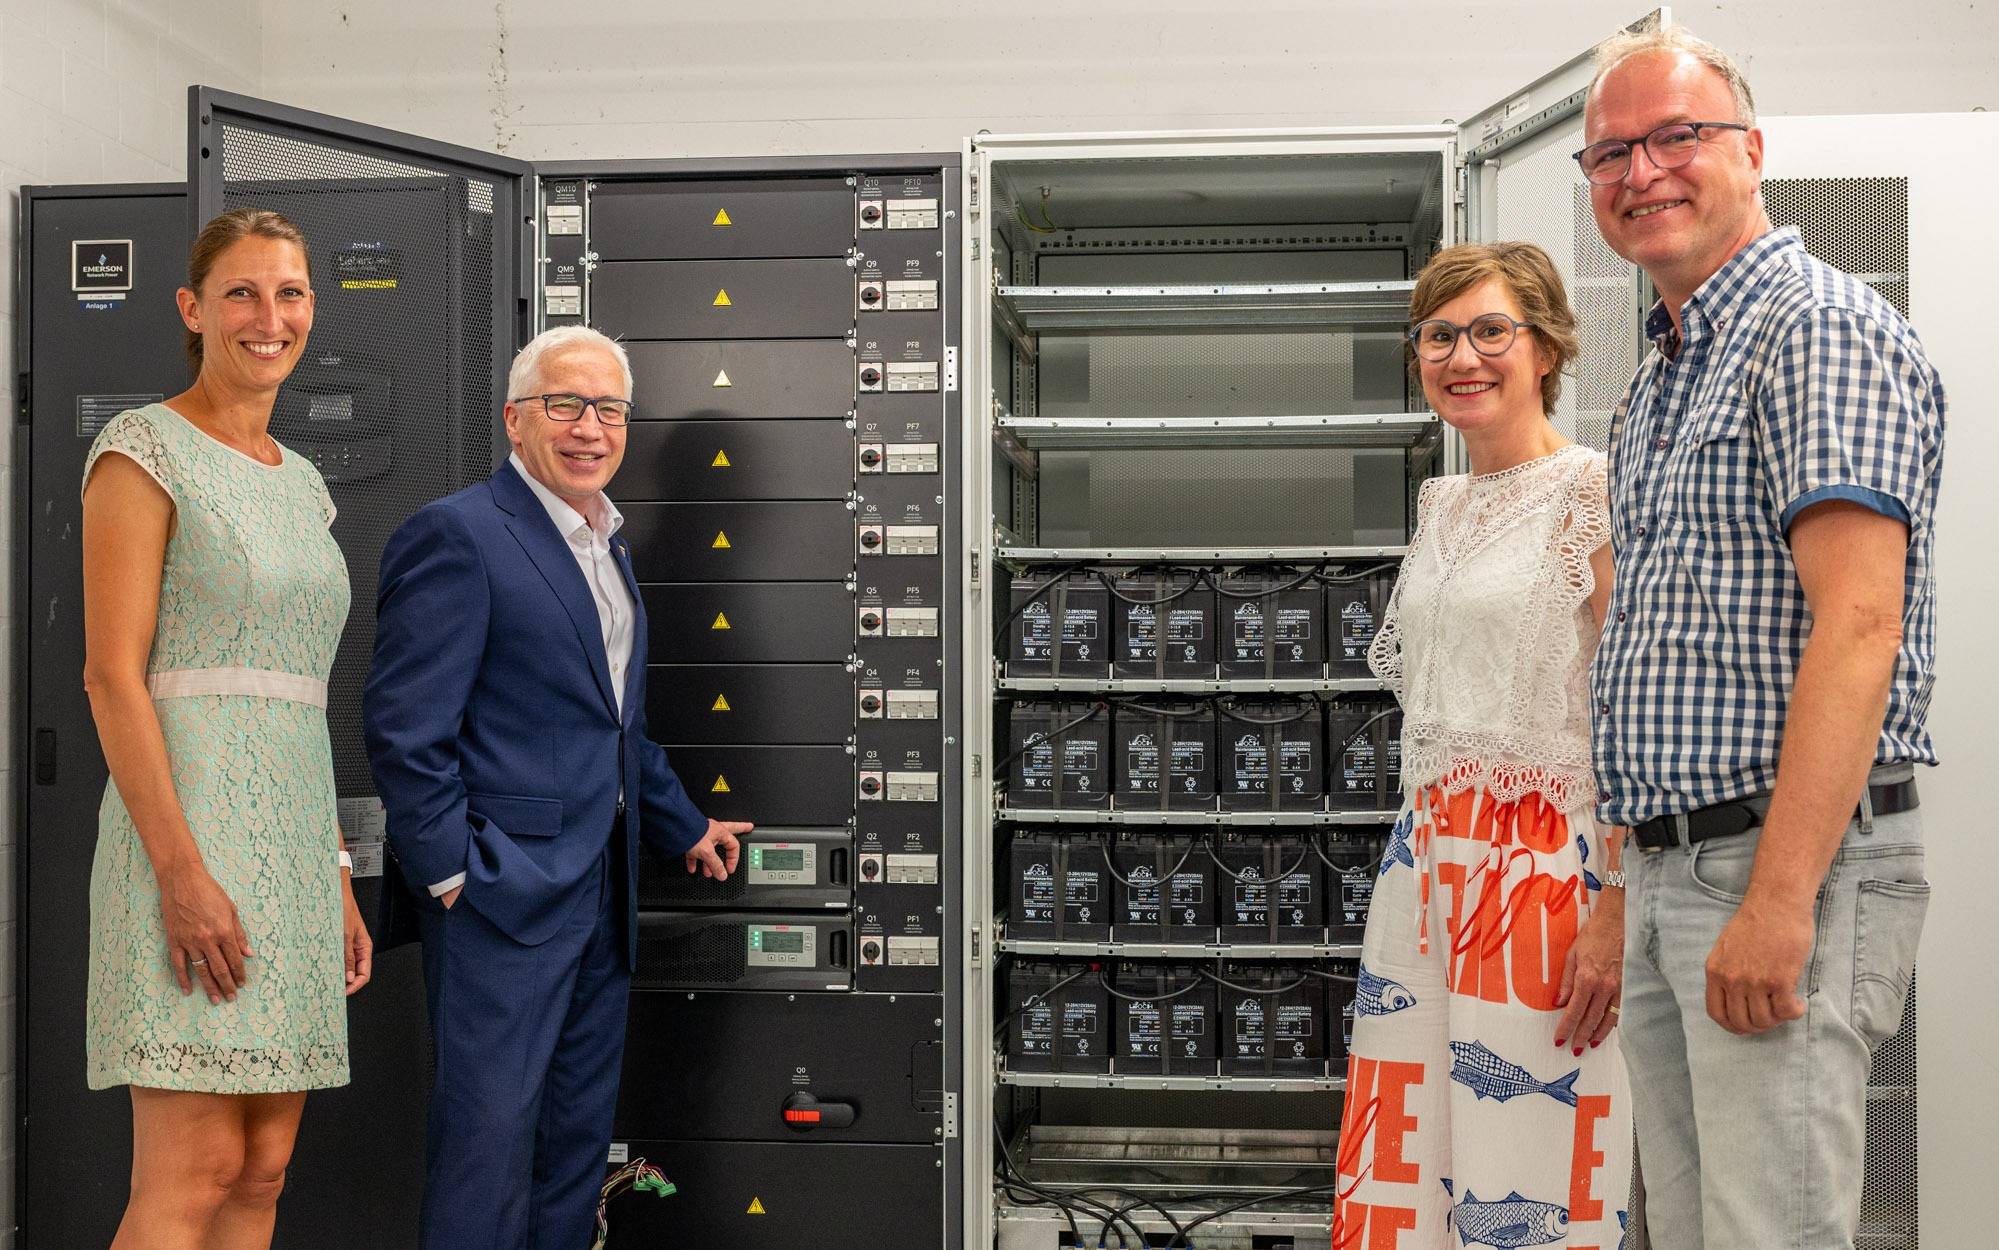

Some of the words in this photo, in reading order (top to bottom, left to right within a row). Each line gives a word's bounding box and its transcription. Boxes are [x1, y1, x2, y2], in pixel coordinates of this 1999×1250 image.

[864, 179, 879, 187] Q10
[555, 185, 577, 193] QM10
[866, 260, 877, 269] Q9
[83, 265, 123, 273] EMERSON
[557, 265, 575, 273] QM9
[86, 302, 108, 310] Anlage
[866, 341, 877, 350] Q8
[906, 341, 920, 349] PF8
[866, 423, 877, 432] Q7
[866, 504, 877, 513] Q6
[907, 504, 920, 512] PF6
[866, 586, 877, 595] Q5
[907, 586, 920, 594] PF5
[866, 669, 877, 677] Q4
[866, 750, 877, 759] Q3
[866, 833, 877, 841] Q2
[866, 915, 877, 923] Q1
[907, 915, 920, 923] PF1
[796, 1066, 806, 1074] Q0
